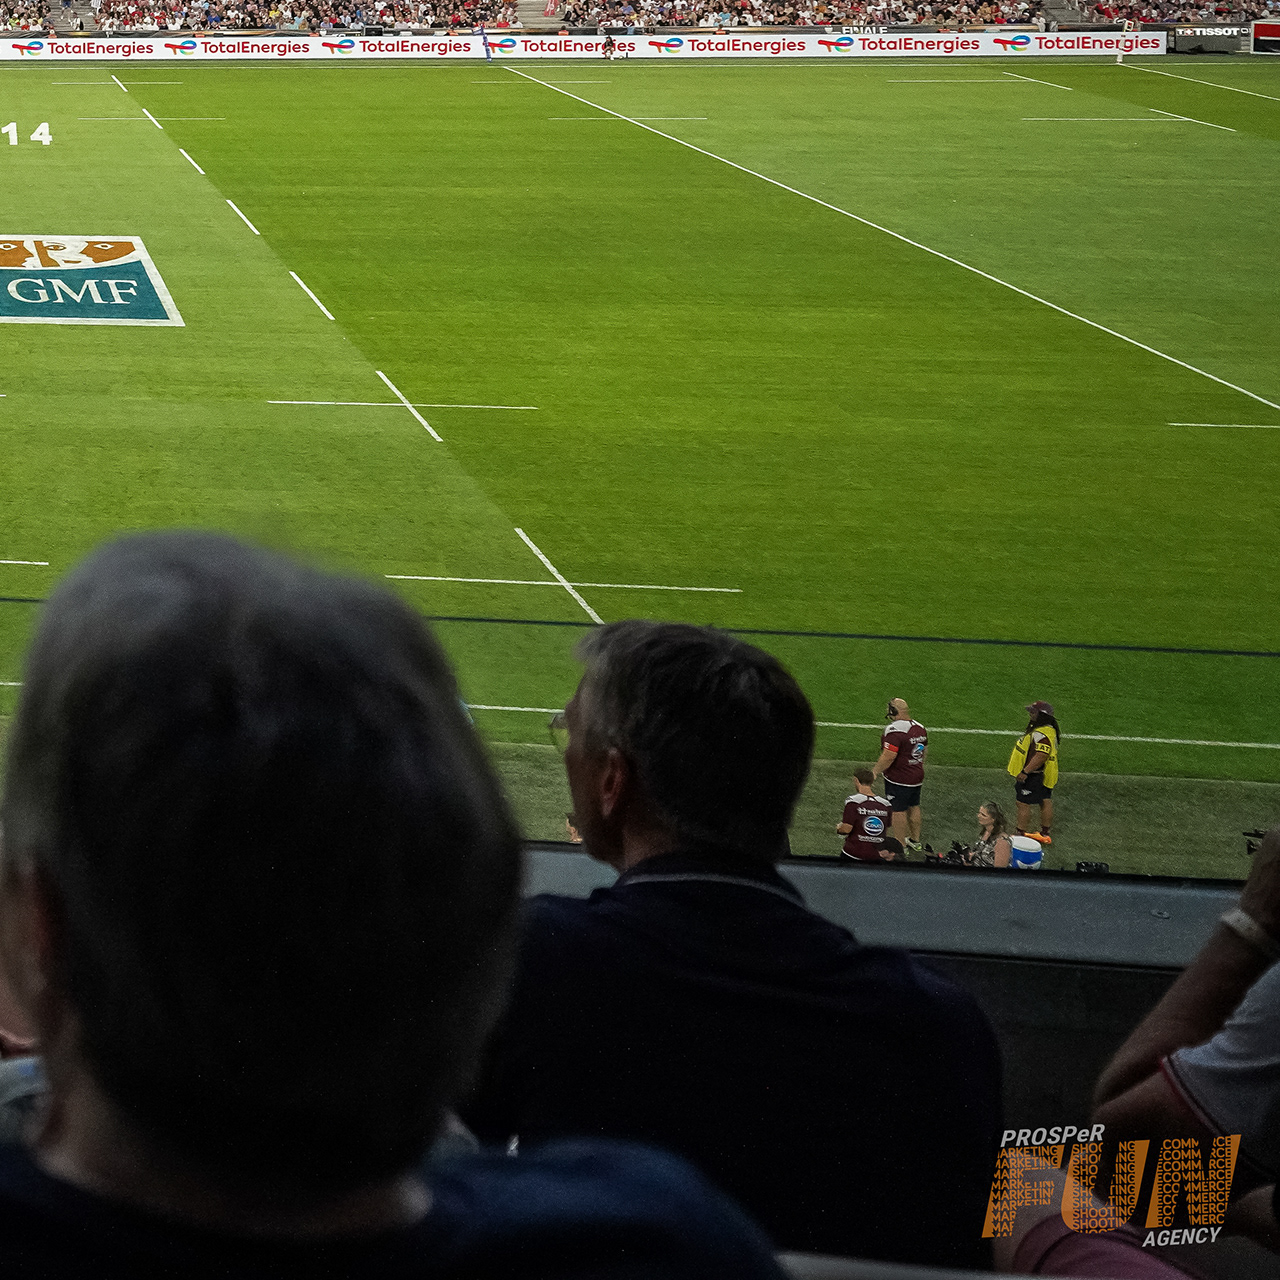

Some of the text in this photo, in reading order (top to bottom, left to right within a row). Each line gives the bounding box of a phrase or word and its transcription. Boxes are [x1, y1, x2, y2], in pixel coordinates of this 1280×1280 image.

[1194, 27, 1239, 36] TISSOT
[47, 42, 153, 57] TotalEnergies
[200, 41, 309, 56] TotalEnergies
[359, 40, 470, 56] TotalEnergies
[521, 39, 635, 55] TotalEneries
[687, 38, 805, 54] TotalEnergies
[858, 37, 979, 53] TotalEnergies
[0, 121, 53, 146] 14
[6, 278, 138, 304] GMF
